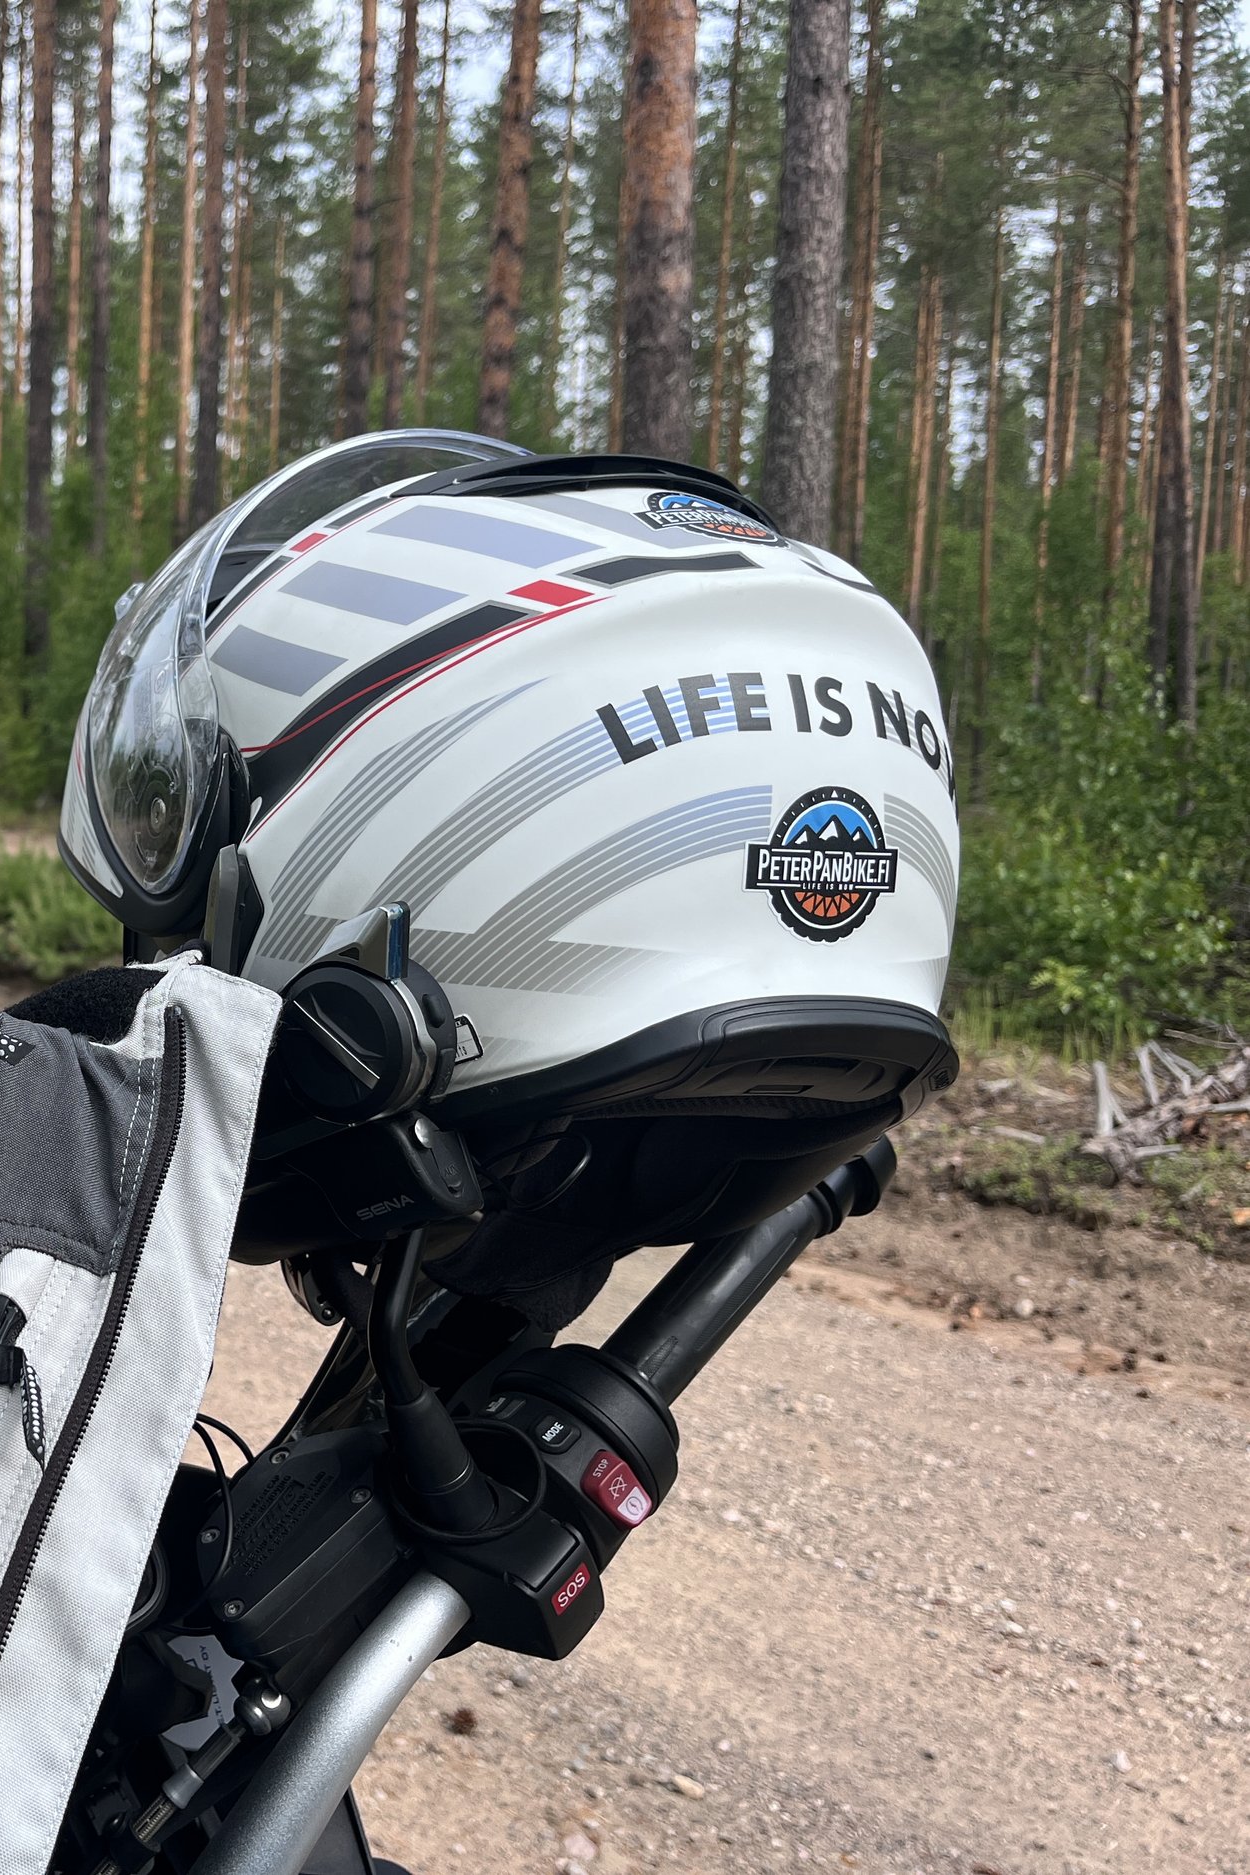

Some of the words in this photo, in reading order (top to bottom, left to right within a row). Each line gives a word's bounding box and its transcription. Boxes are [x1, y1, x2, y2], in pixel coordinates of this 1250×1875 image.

[596, 672, 772, 765] LIFE
[786, 673, 853, 737] IS
[356, 1194, 415, 1221] SENA
[542, 1421, 564, 1442] MODE
[592, 1458, 609, 1478] STOP
[557, 1571, 586, 1608] SOS
